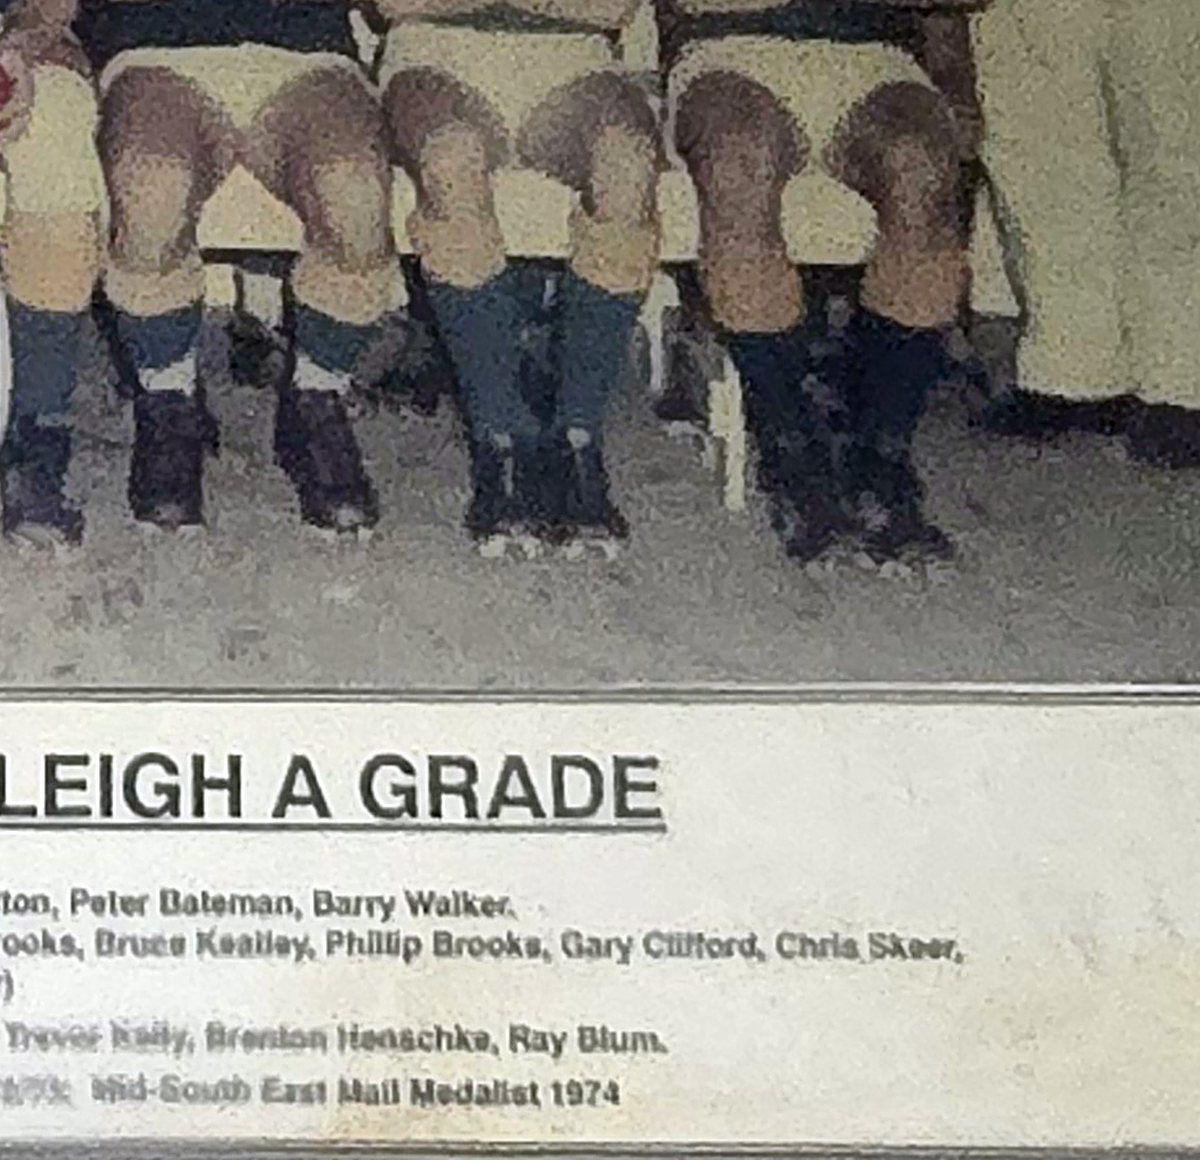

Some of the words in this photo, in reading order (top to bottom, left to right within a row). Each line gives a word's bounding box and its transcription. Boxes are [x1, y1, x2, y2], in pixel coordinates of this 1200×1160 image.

[272, 755, 334, 820] A
[360, 754, 665, 820] GRADE
[71, 888, 151, 919] Peter
[160, 888, 305, 924] Bateman,
[314, 889, 398, 923] Barry
[95, 928, 187, 960] Bruce
[196, 930, 318, 962] Keatley,
[432, 930, 552, 962] Brooks,
[561, 930, 634, 964] Gary
[641, 930, 767, 961] Clifford,
[774, 931, 858, 961] Chris
[509, 1024, 568, 1057] Ray
[260, 1077, 328, 1105] East
[408, 1077, 542, 1107] Medalist
[550, 1078, 622, 1106] 1974
